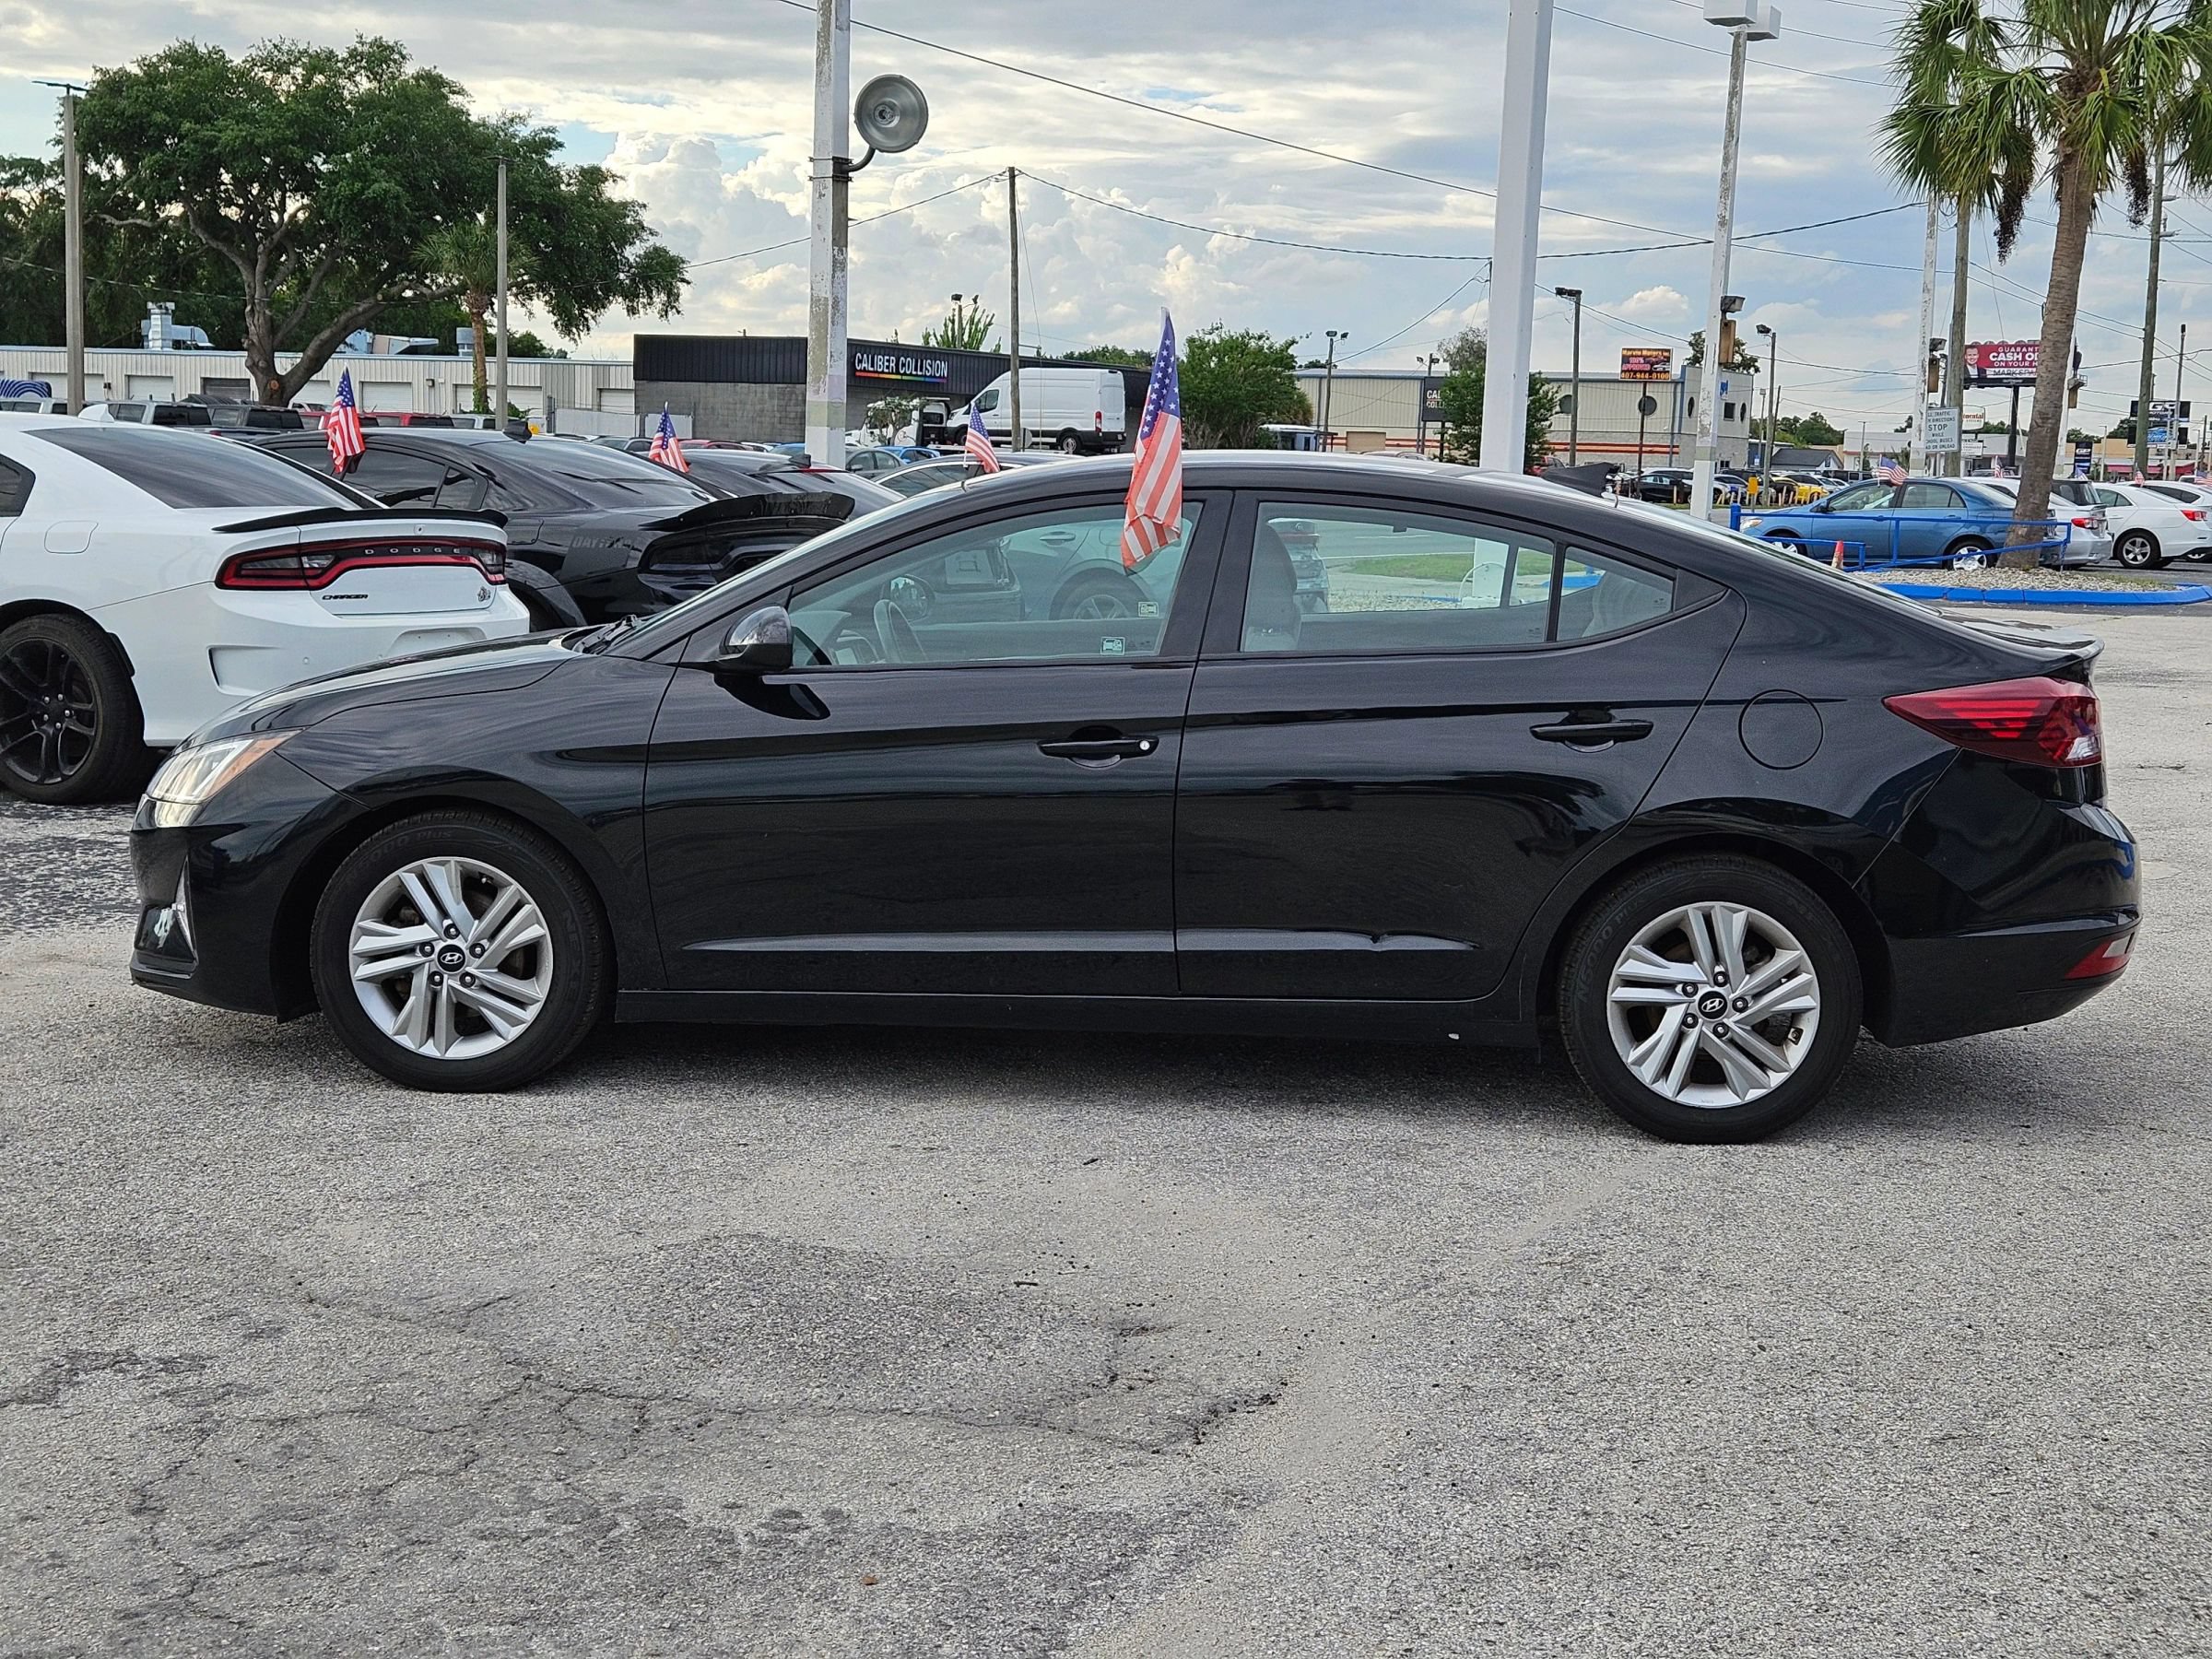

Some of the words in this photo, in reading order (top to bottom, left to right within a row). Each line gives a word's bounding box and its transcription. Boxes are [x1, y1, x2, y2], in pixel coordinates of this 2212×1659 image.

[1989, 352, 2022, 360] CASH
[855, 353, 896, 372] CALIBER
[899, 357, 947, 377] COLLISION
